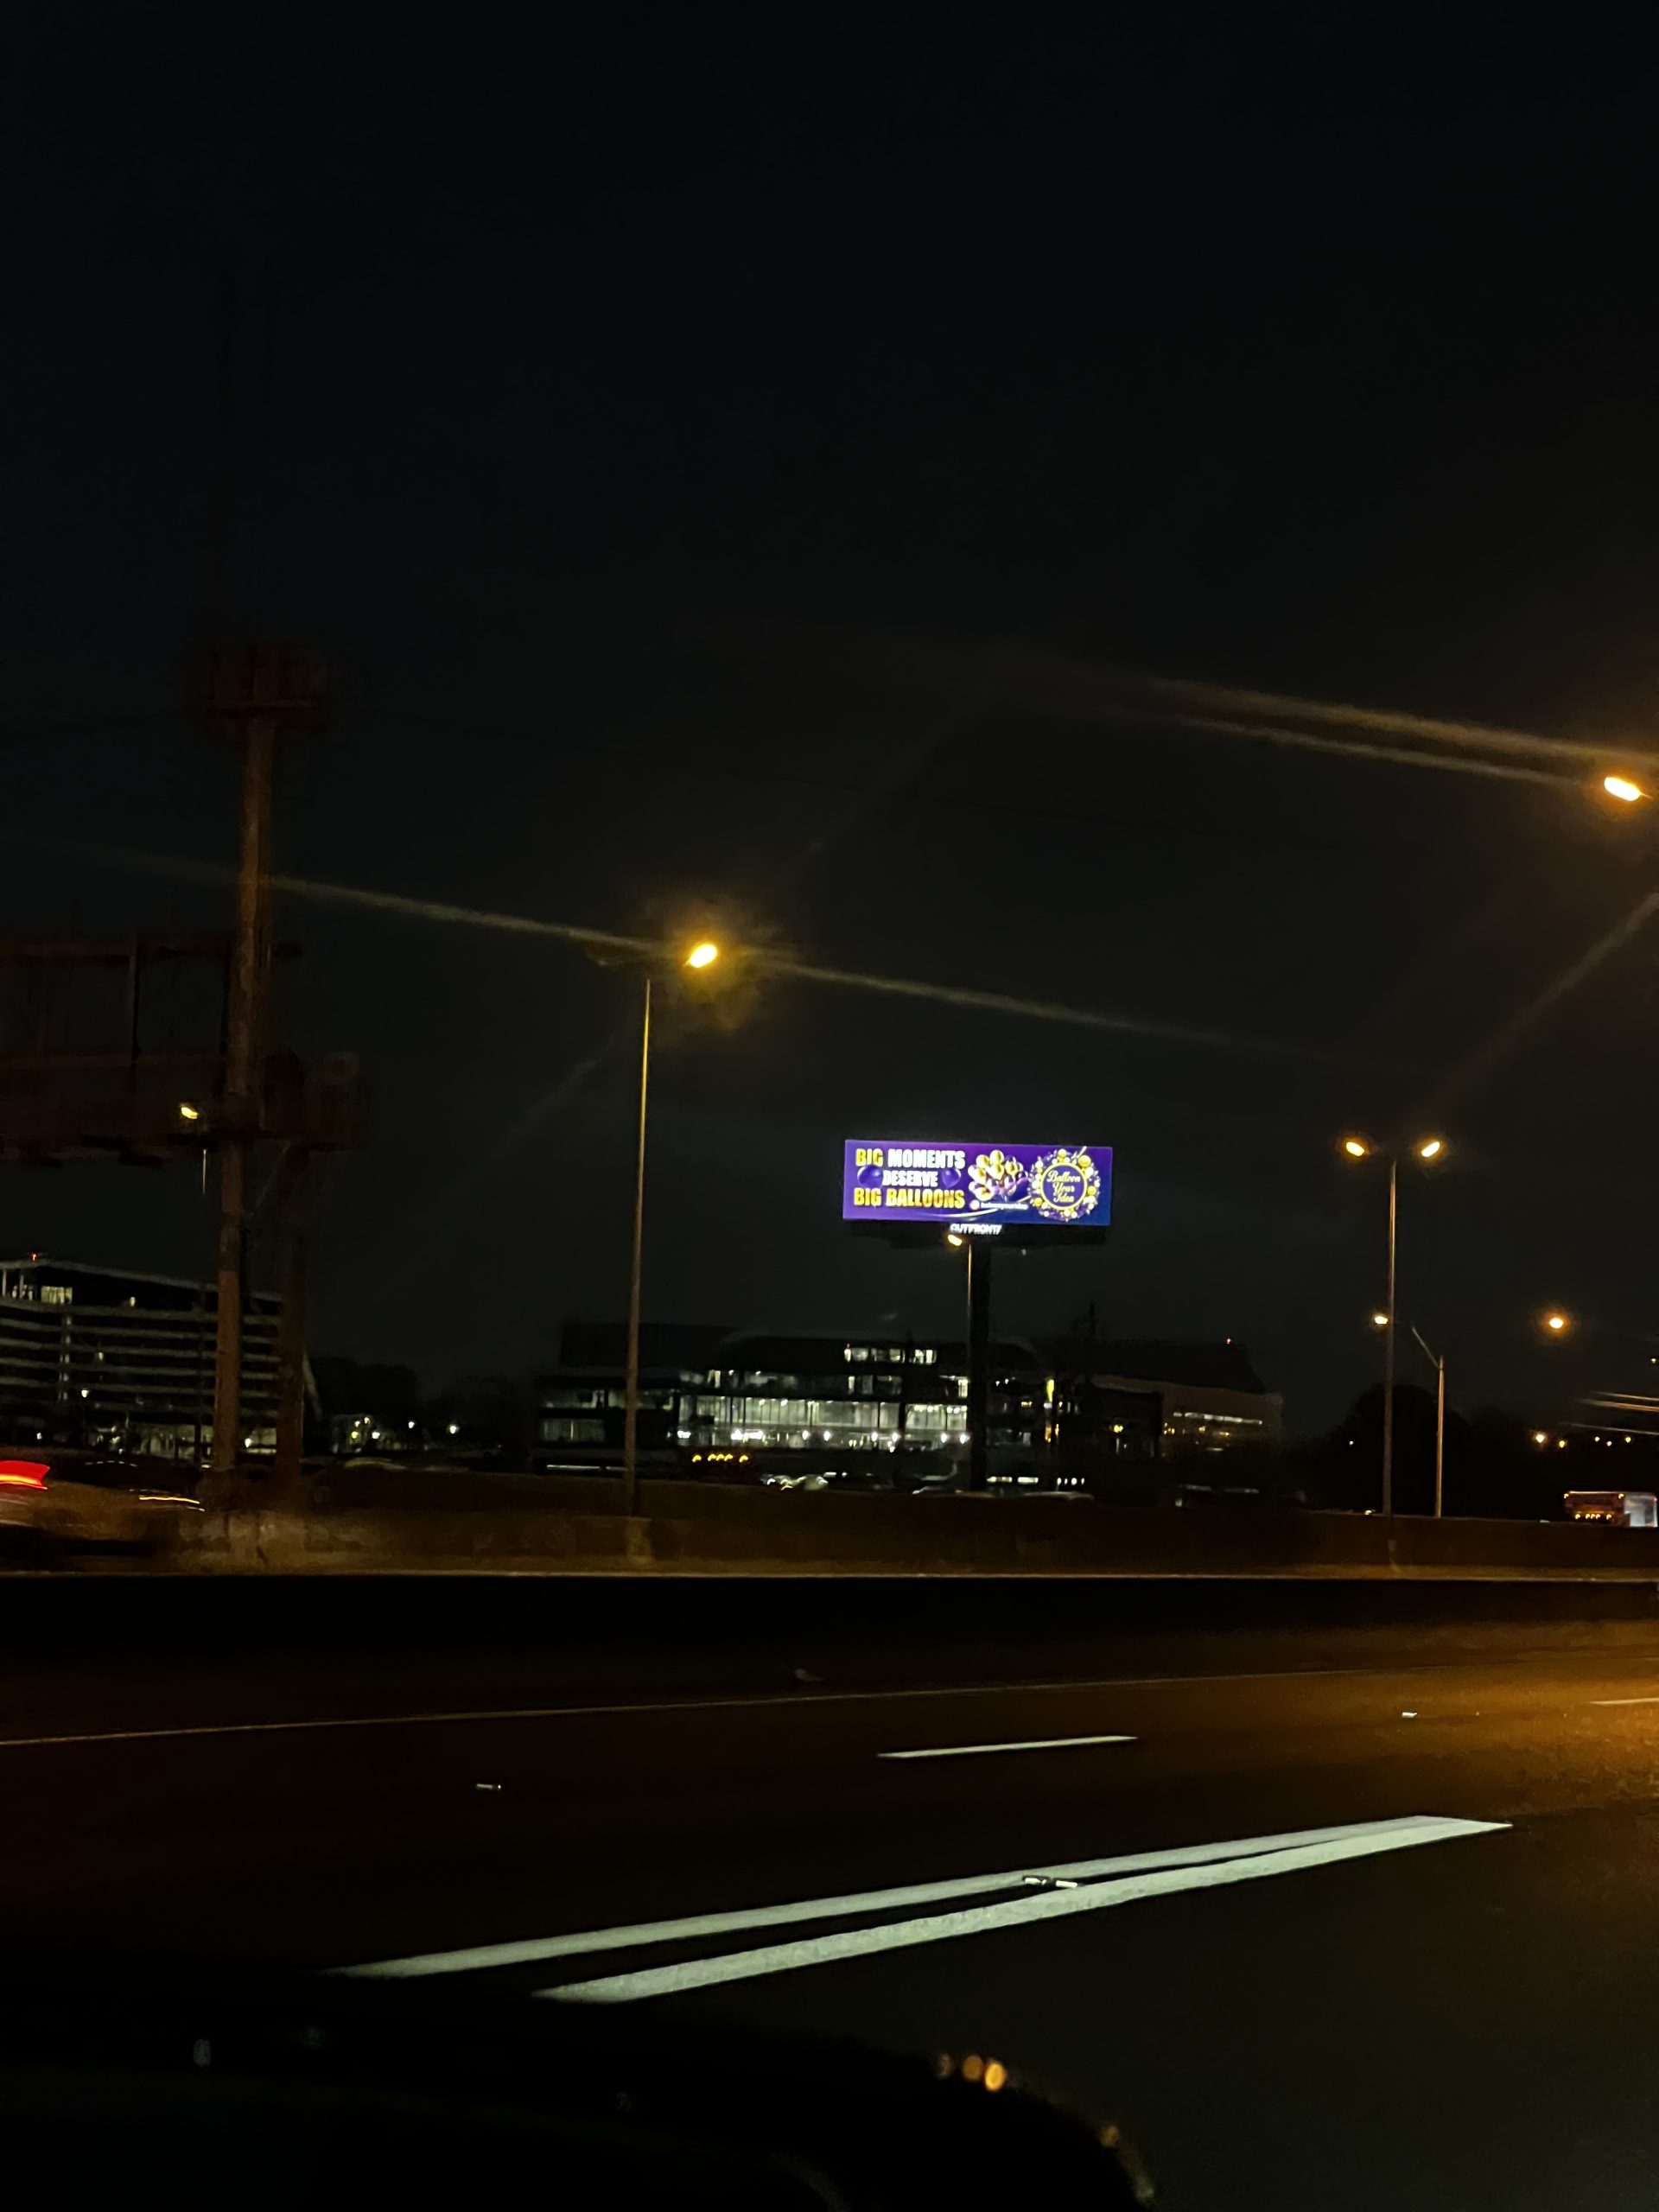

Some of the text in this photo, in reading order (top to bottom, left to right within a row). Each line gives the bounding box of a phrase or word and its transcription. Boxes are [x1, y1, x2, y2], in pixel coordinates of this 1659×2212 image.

[855, 1148, 966, 1169] BIG MOMENTS
[882, 1169, 938, 1187] DESERVE
[1046, 1170, 1081, 1183] Balloon
[854, 1187, 965, 1209] BIG BALLOONS
[1052, 1182, 1075, 1196] Your
